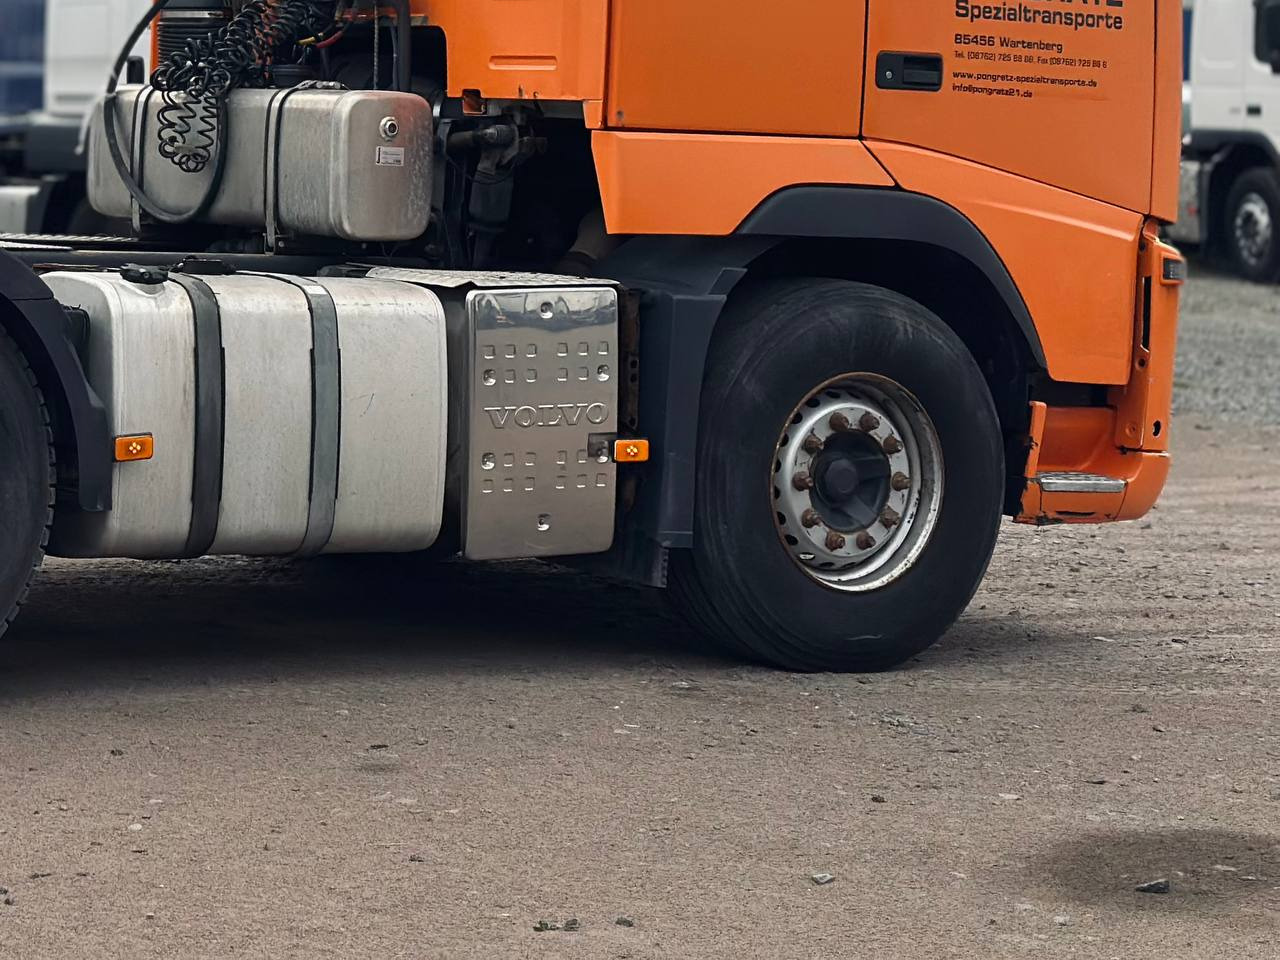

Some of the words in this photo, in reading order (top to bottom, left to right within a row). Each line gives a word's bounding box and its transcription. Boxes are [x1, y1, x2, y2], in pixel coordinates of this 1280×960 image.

[954, 33, 995, 47] 85456
[999, 36, 1063, 54] Wartenberg
[483, 402, 609, 429] VOLVO
